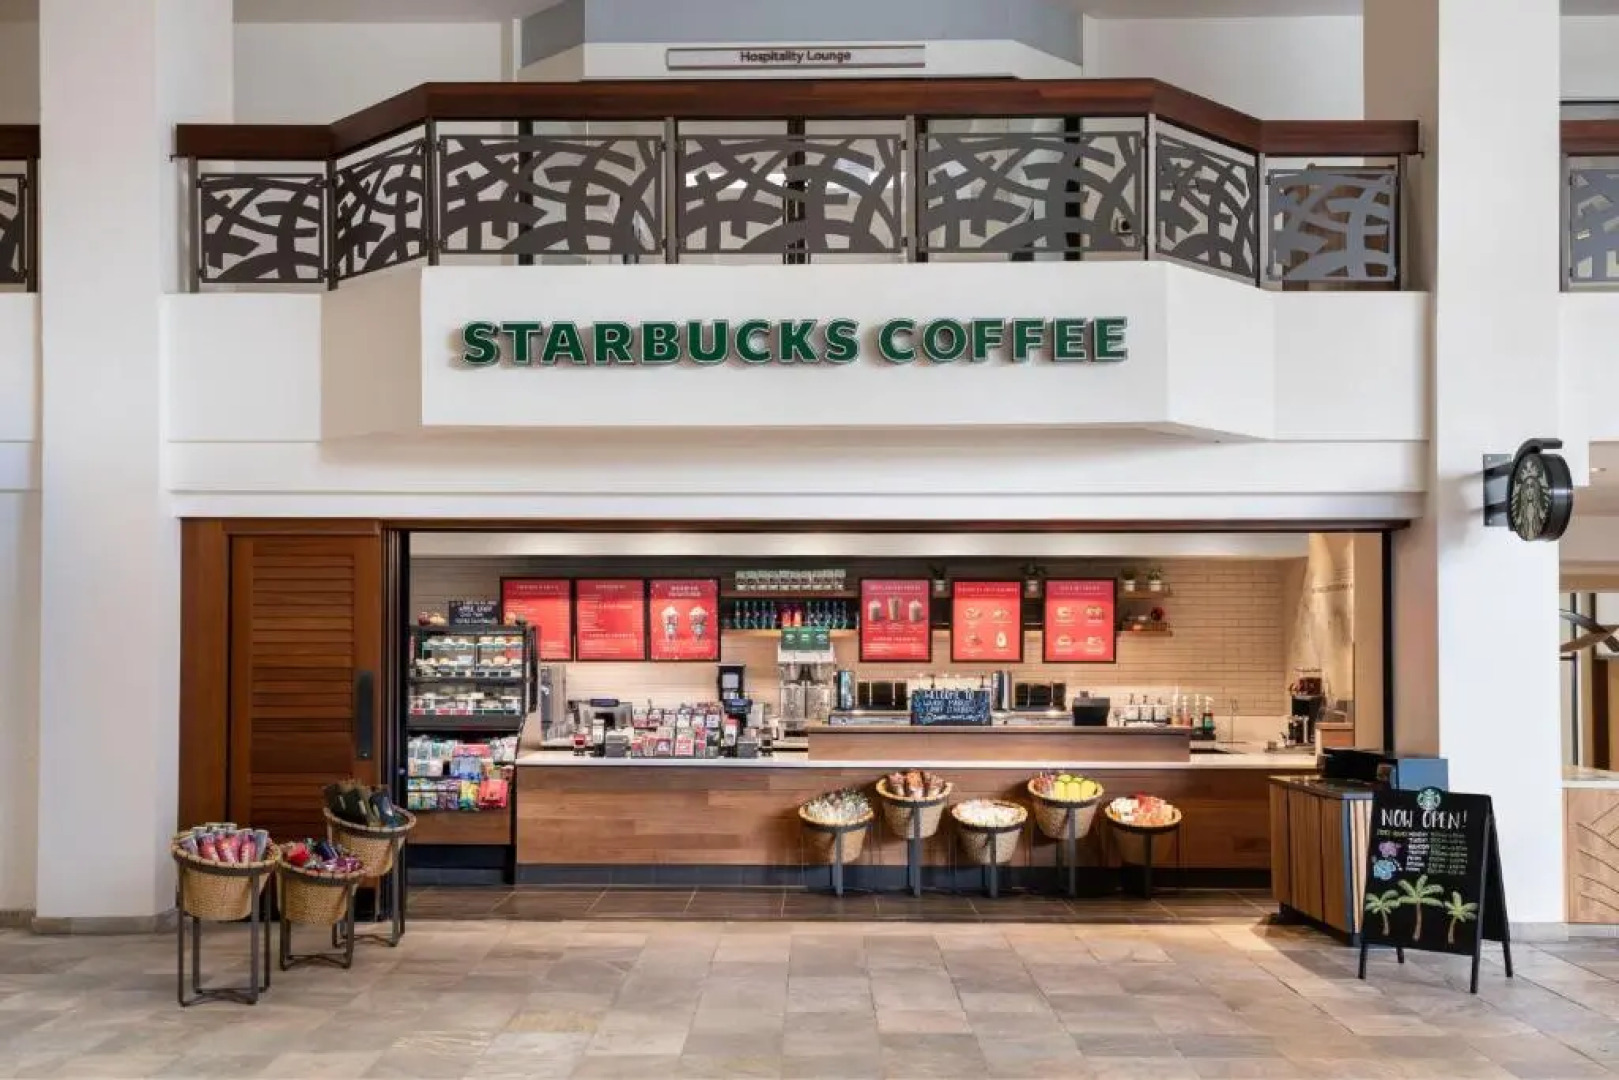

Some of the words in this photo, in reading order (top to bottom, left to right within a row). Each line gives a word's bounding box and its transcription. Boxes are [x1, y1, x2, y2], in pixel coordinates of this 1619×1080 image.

[741, 50, 803, 63] Hospitality
[807, 50, 852, 63] Lounge
[462, 319, 860, 365] STARBUCKS
[878, 317, 1128, 363] COFFEE
[1381, 808, 1413, 828] NOW
[1422, 810, 1467, 829] OPEN!
